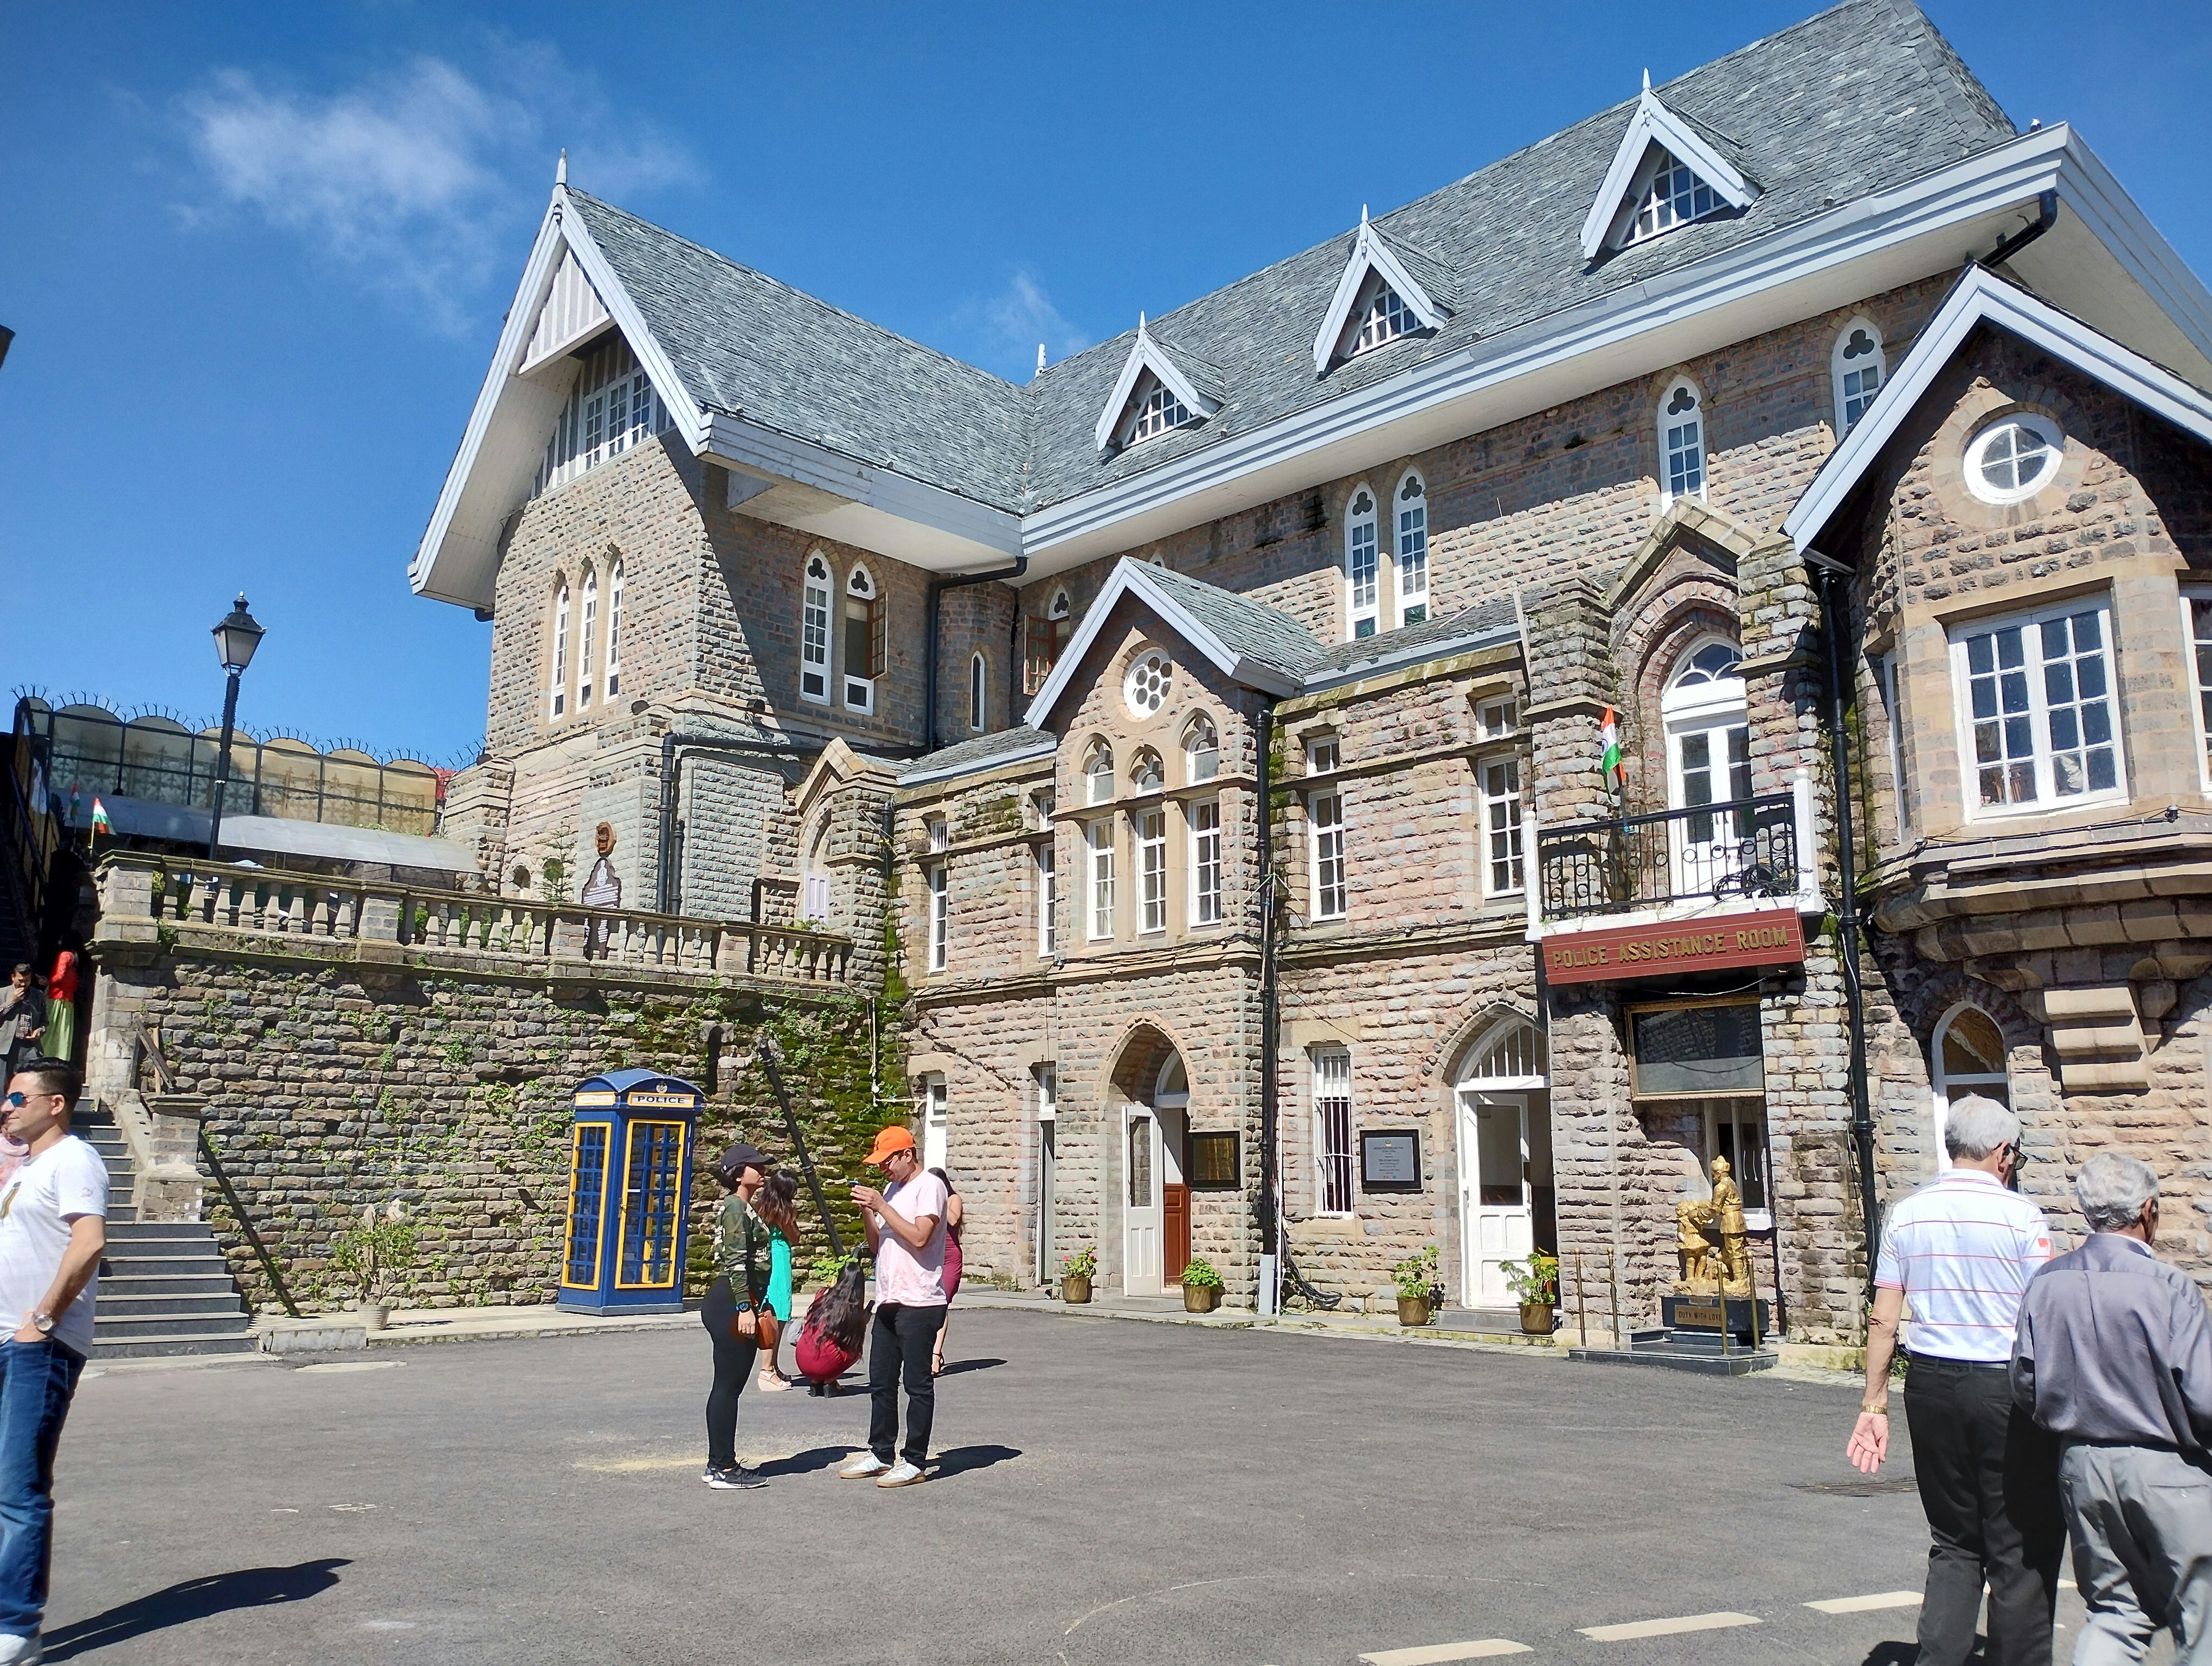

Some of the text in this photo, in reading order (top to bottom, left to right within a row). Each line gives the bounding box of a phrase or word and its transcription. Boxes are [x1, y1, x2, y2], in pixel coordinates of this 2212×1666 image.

[1552, 926, 1788, 969] POLICE ASSISTANCE ROOM
